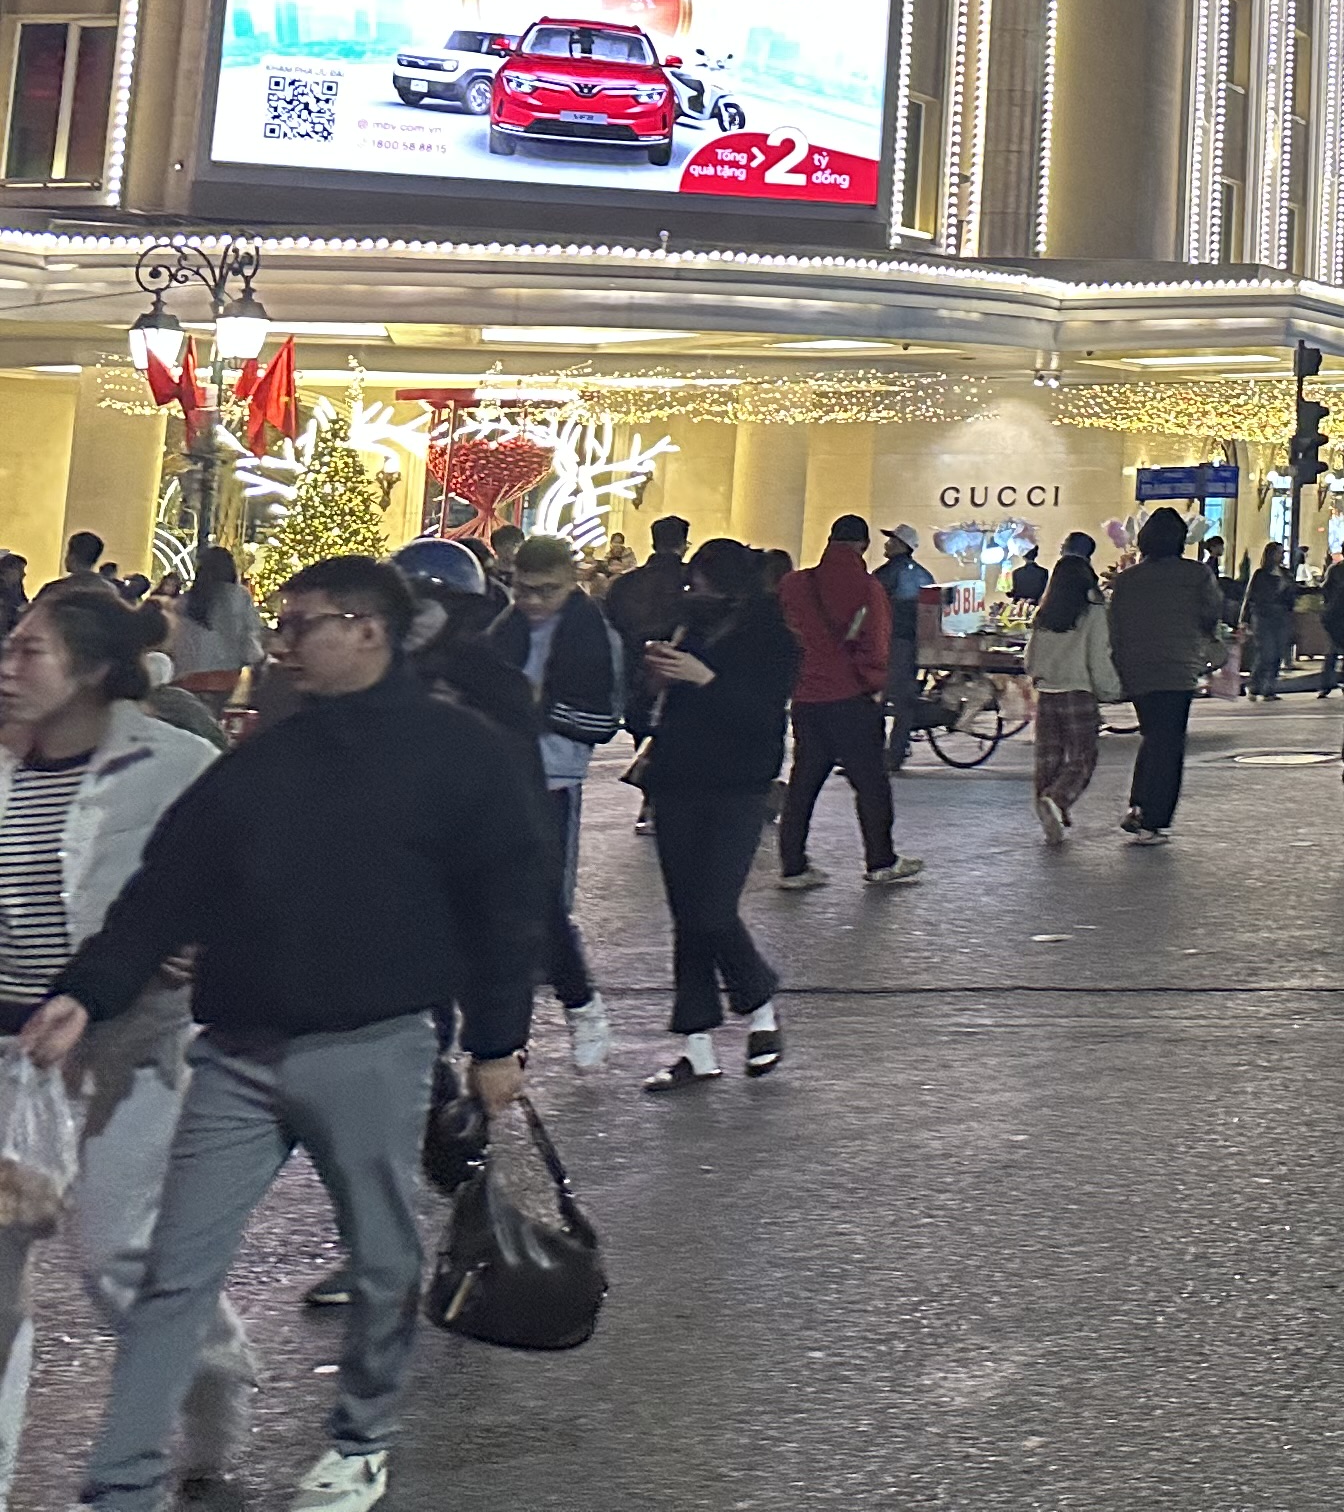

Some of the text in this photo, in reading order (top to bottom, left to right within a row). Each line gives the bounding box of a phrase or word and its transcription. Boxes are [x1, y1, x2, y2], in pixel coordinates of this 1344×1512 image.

[371, 139, 399, 151] 1800
[436, 144, 447, 154] 15
[763, 125, 810, 187] 2
[689, 163, 747, 181] quà tặng
[811, 169, 850, 189] đồng
[939, 485, 1060, 509] GUCCI
